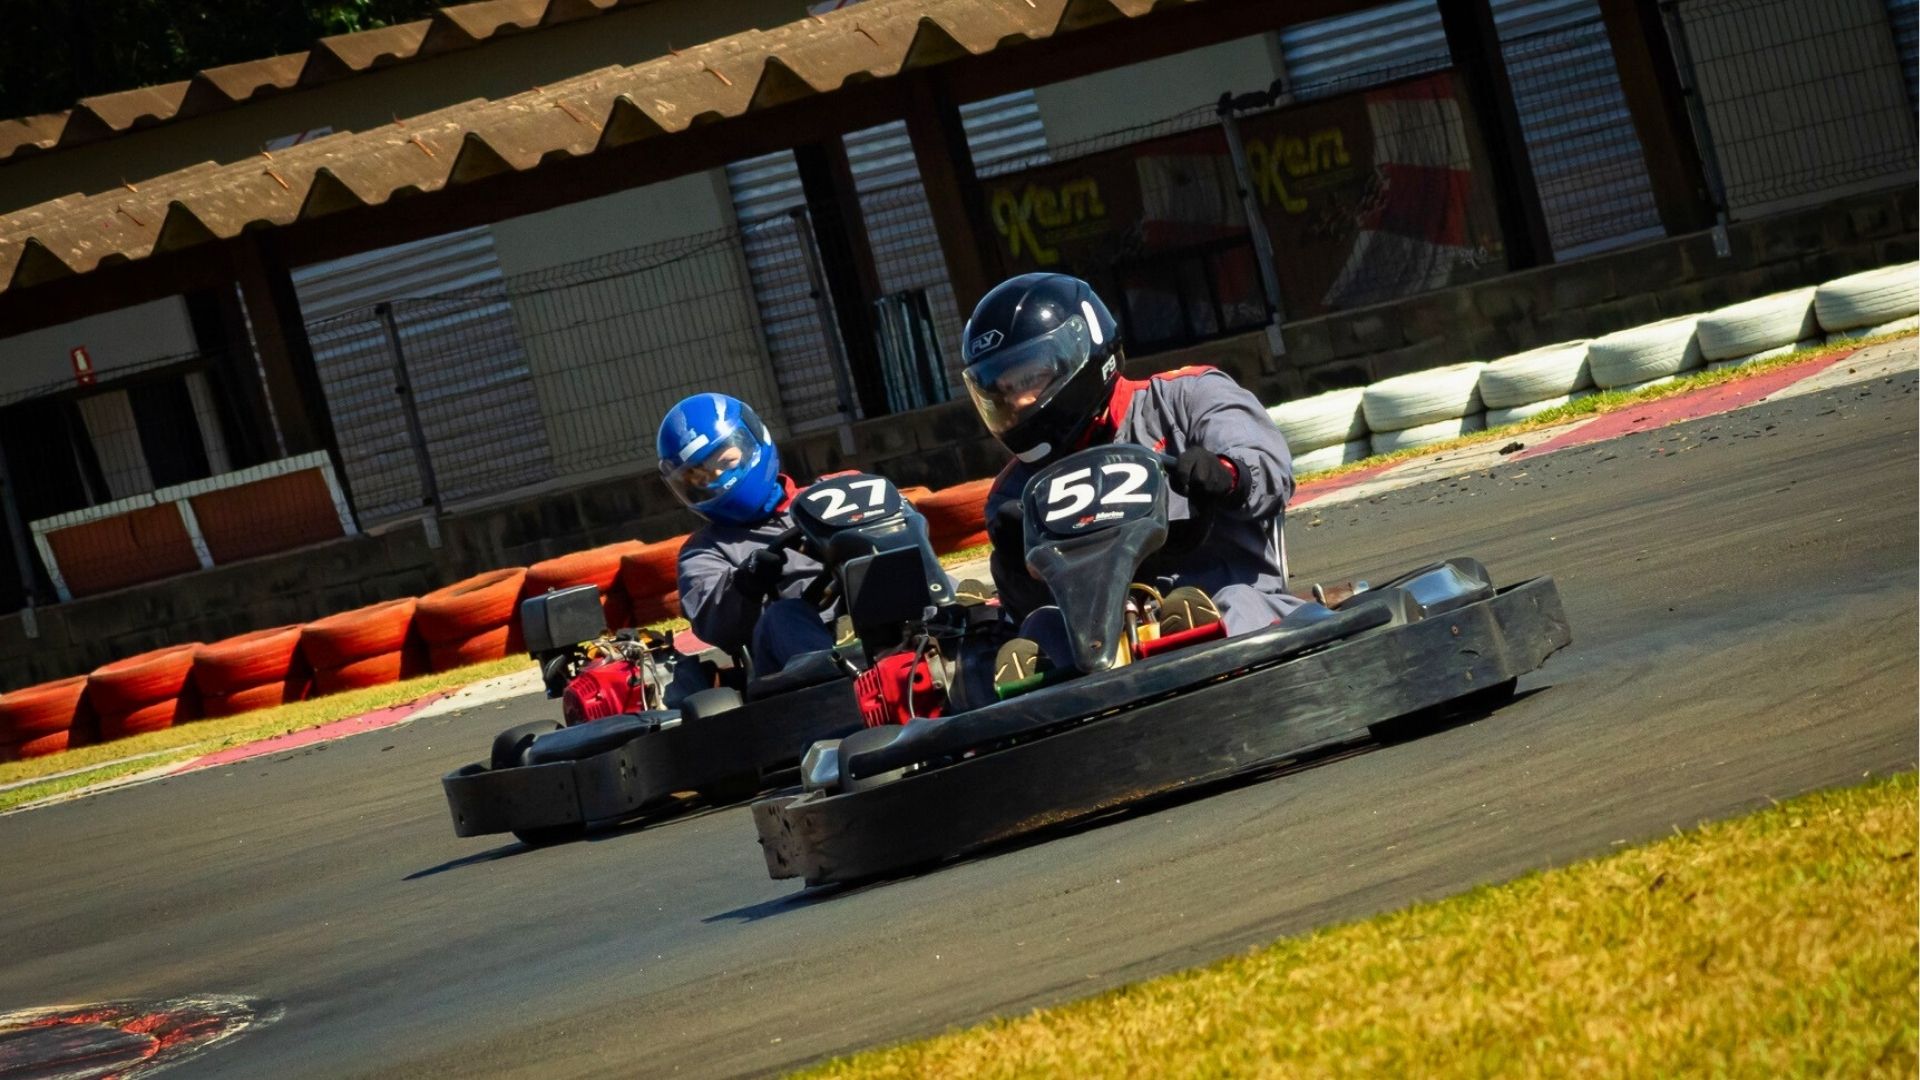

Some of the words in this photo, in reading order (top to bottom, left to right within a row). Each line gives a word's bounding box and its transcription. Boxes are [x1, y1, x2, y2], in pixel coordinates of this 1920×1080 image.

[971, 333, 995, 354] FLY
[1101, 354, 1117, 381] F9
[807, 478, 886, 519] 27
[1045, 463, 1152, 521] 52
